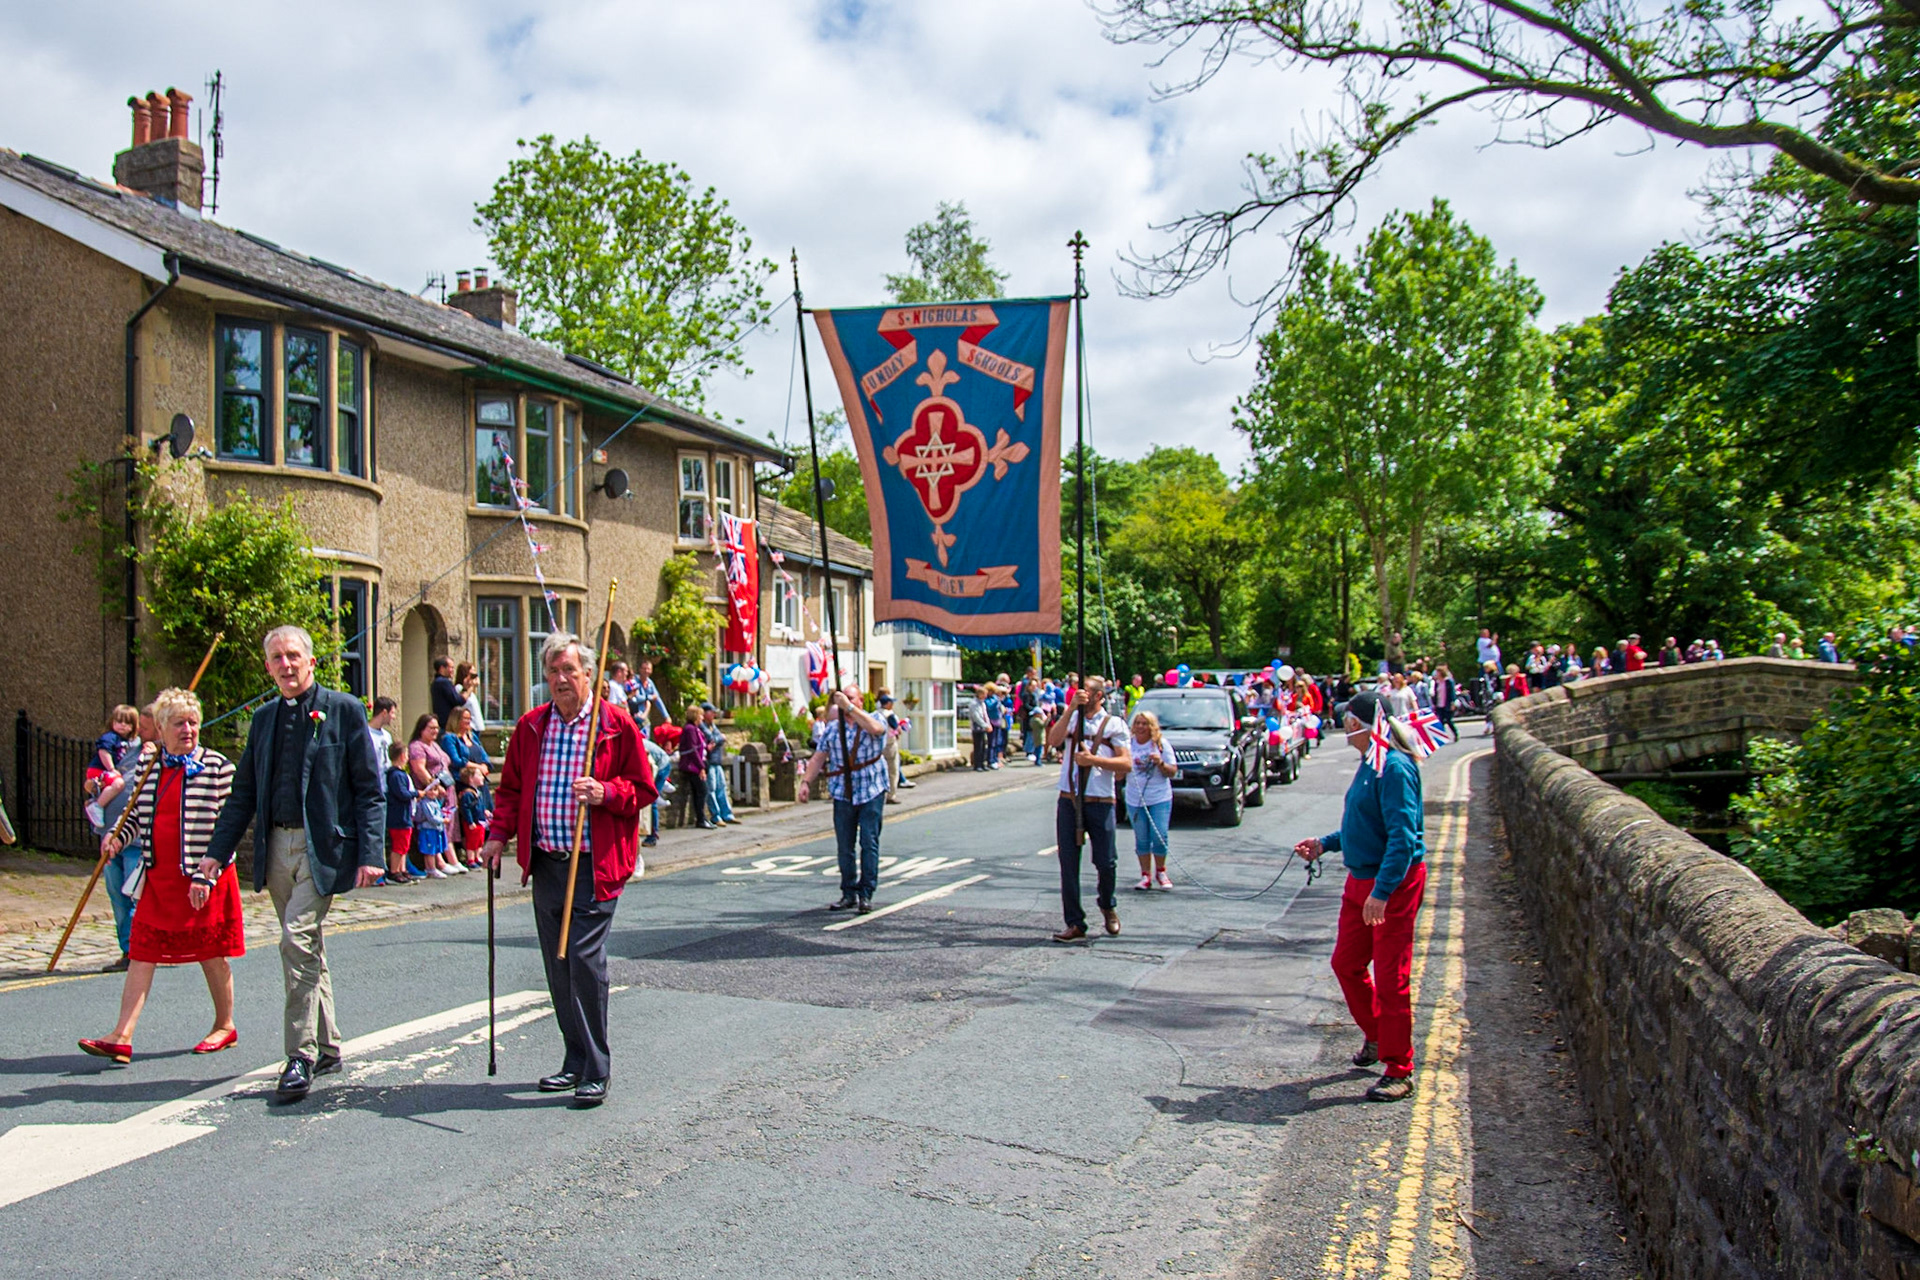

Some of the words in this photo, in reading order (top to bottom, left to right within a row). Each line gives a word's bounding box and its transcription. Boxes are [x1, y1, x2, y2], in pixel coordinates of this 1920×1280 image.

[913, 308, 977, 325] NICHOLAS
[967, 349, 1021, 381] SCHOOLS
[720, 855, 976, 880] SLOW
